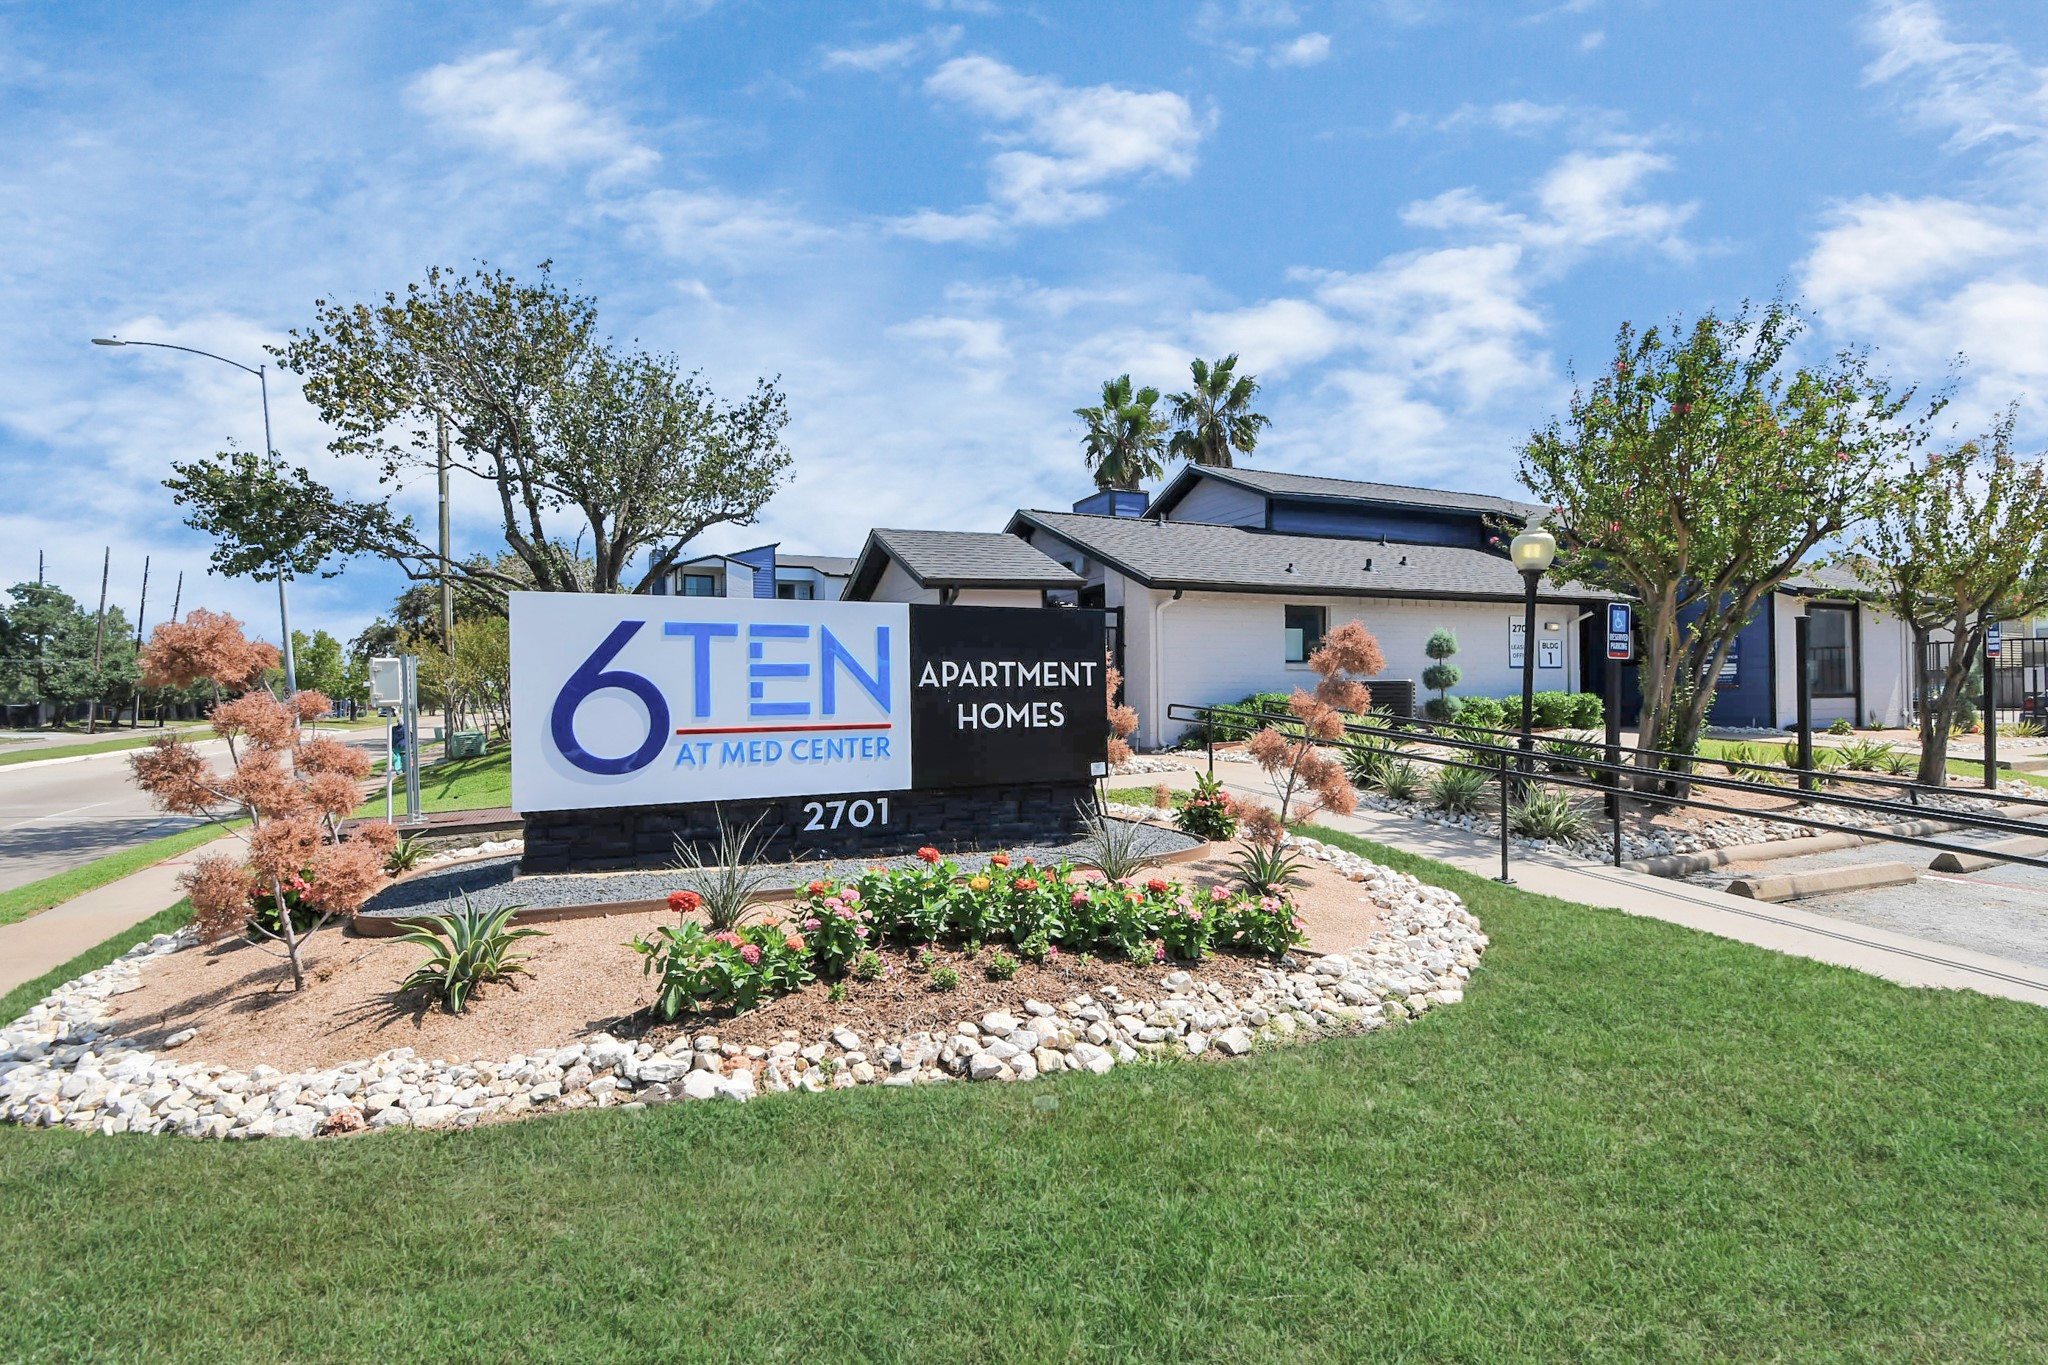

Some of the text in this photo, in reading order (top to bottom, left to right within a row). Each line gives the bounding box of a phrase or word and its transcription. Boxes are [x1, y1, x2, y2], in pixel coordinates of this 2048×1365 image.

[1542, 642, 1559, 650] BLDG
[1548, 652, 1553, 665] 1
[1610, 642, 1628, 651] PARKING
[918, 661, 1097, 688] APARTMENT
[958, 702, 1065, 730] HOMES
[675, 734, 891, 766] AT MED CENTER
[803, 797, 889, 831] 2701
